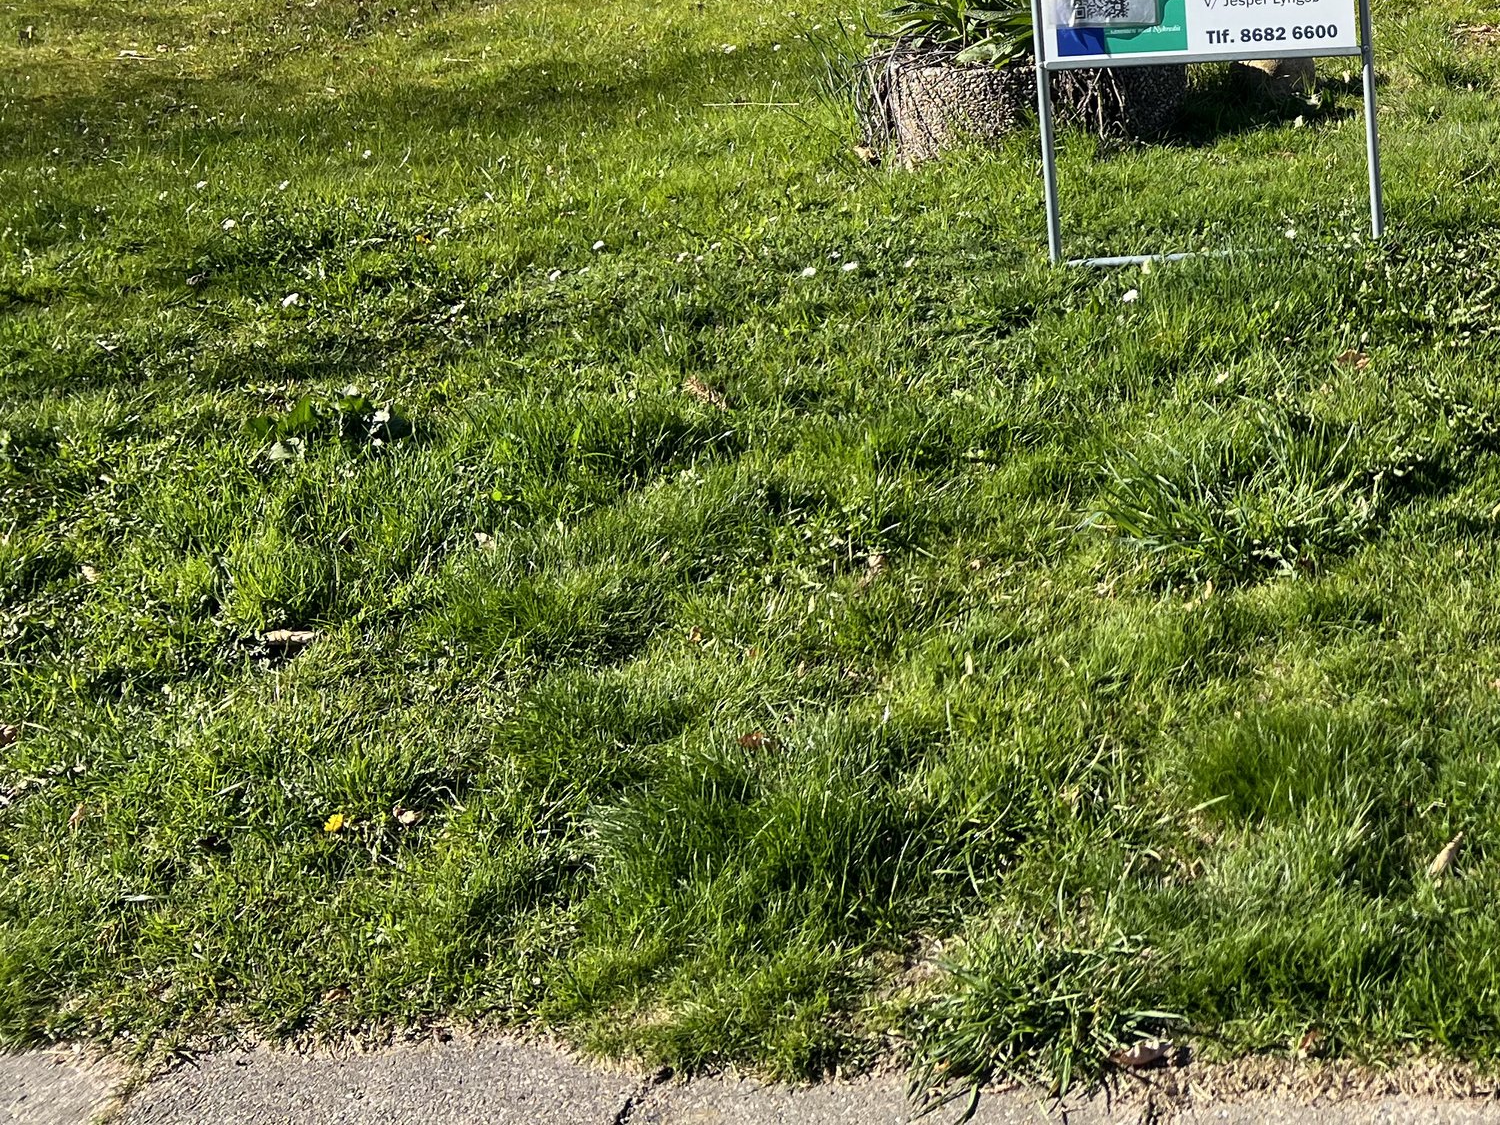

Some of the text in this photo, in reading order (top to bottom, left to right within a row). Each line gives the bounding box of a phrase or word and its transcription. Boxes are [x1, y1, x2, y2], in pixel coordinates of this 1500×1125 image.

[1205, 24, 1338, 44] Tlf. 8682 6600
